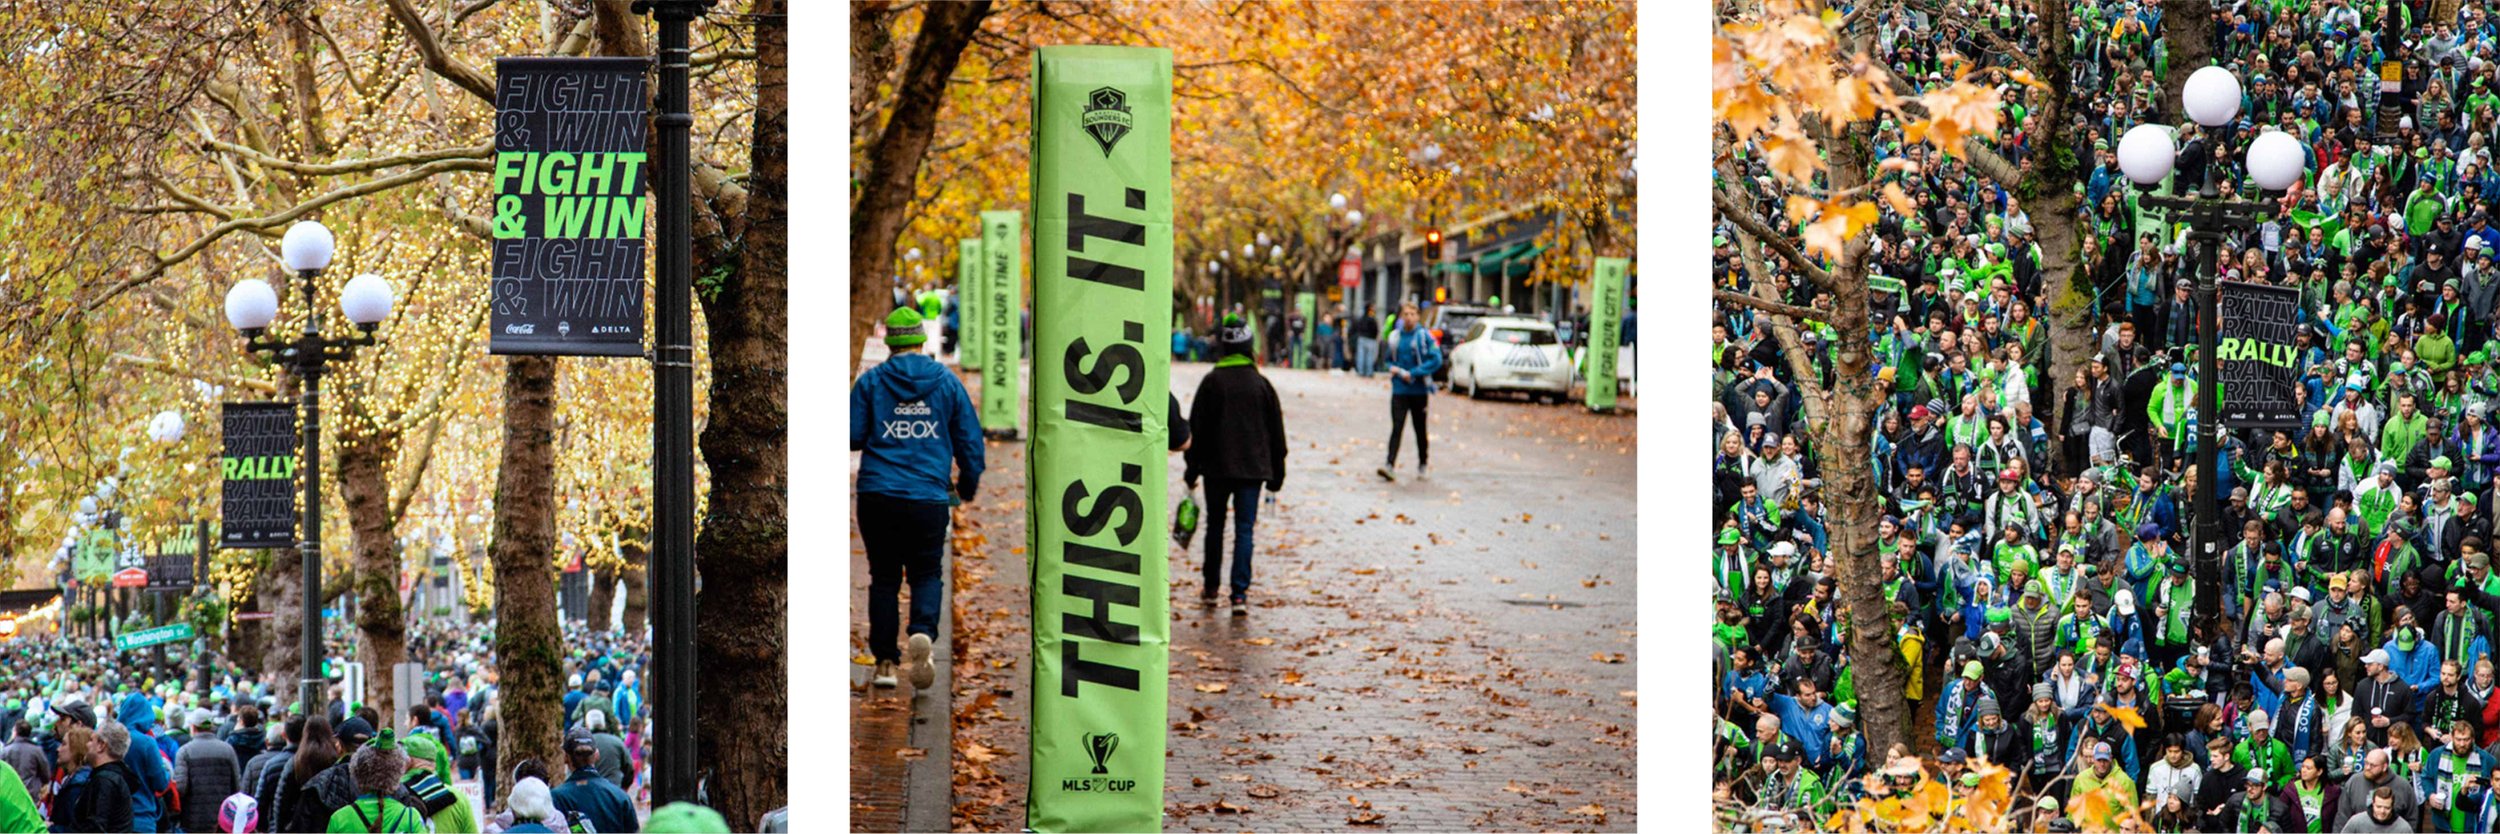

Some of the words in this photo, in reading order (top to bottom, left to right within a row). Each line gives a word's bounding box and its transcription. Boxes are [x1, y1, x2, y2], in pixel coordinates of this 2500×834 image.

[496, 73, 648, 112] FIGHT
[496, 109, 531, 153] &
[547, 111, 648, 153] WIN
[494, 151, 647, 195] FIGHT
[493, 194, 527, 239] &
[544, 196, 646, 239] WIN
[1066, 187, 1146, 291] IT.
[493, 237, 646, 280] FIGHT
[994, 250, 1008, 289] TIME
[491, 276, 527, 316] &
[544, 279, 645, 317] WIN
[994, 292, 1007, 326] OUR
[1605, 285, 1617, 317] CITY
[2223, 296, 2299, 325] RALLY
[600, 325, 631, 334] DELTA
[993, 330, 1007, 346] IS
[1603, 321, 1615, 347] OUR
[2223, 317, 2299, 347] RALLY
[1601, 351, 1613, 378] FOR
[2222, 337, 2299, 369] RALLY
[993, 349, 1007, 387] NOW
[1064, 320, 1145, 433] IS.
[2223, 359, 2298, 389] RALLY
[2224, 380, 2298, 407] RALLY
[894, 405, 931, 415] adidas
[223, 415, 296, 437] RALLY
[882, 420, 940, 439] XBOX
[223, 436, 296, 457] RALLY
[222, 456, 296, 480] RALLY
[223, 479, 295, 500] RALLY
[223, 499, 295, 521] RALLY
[161, 536, 194, 555] WIN
[1061, 462, 1144, 698] THIS.
[126, 628, 174, 646] Washington
[1062, 780, 1091, 791] MLS
[1108, 780, 1136, 791] CUP
